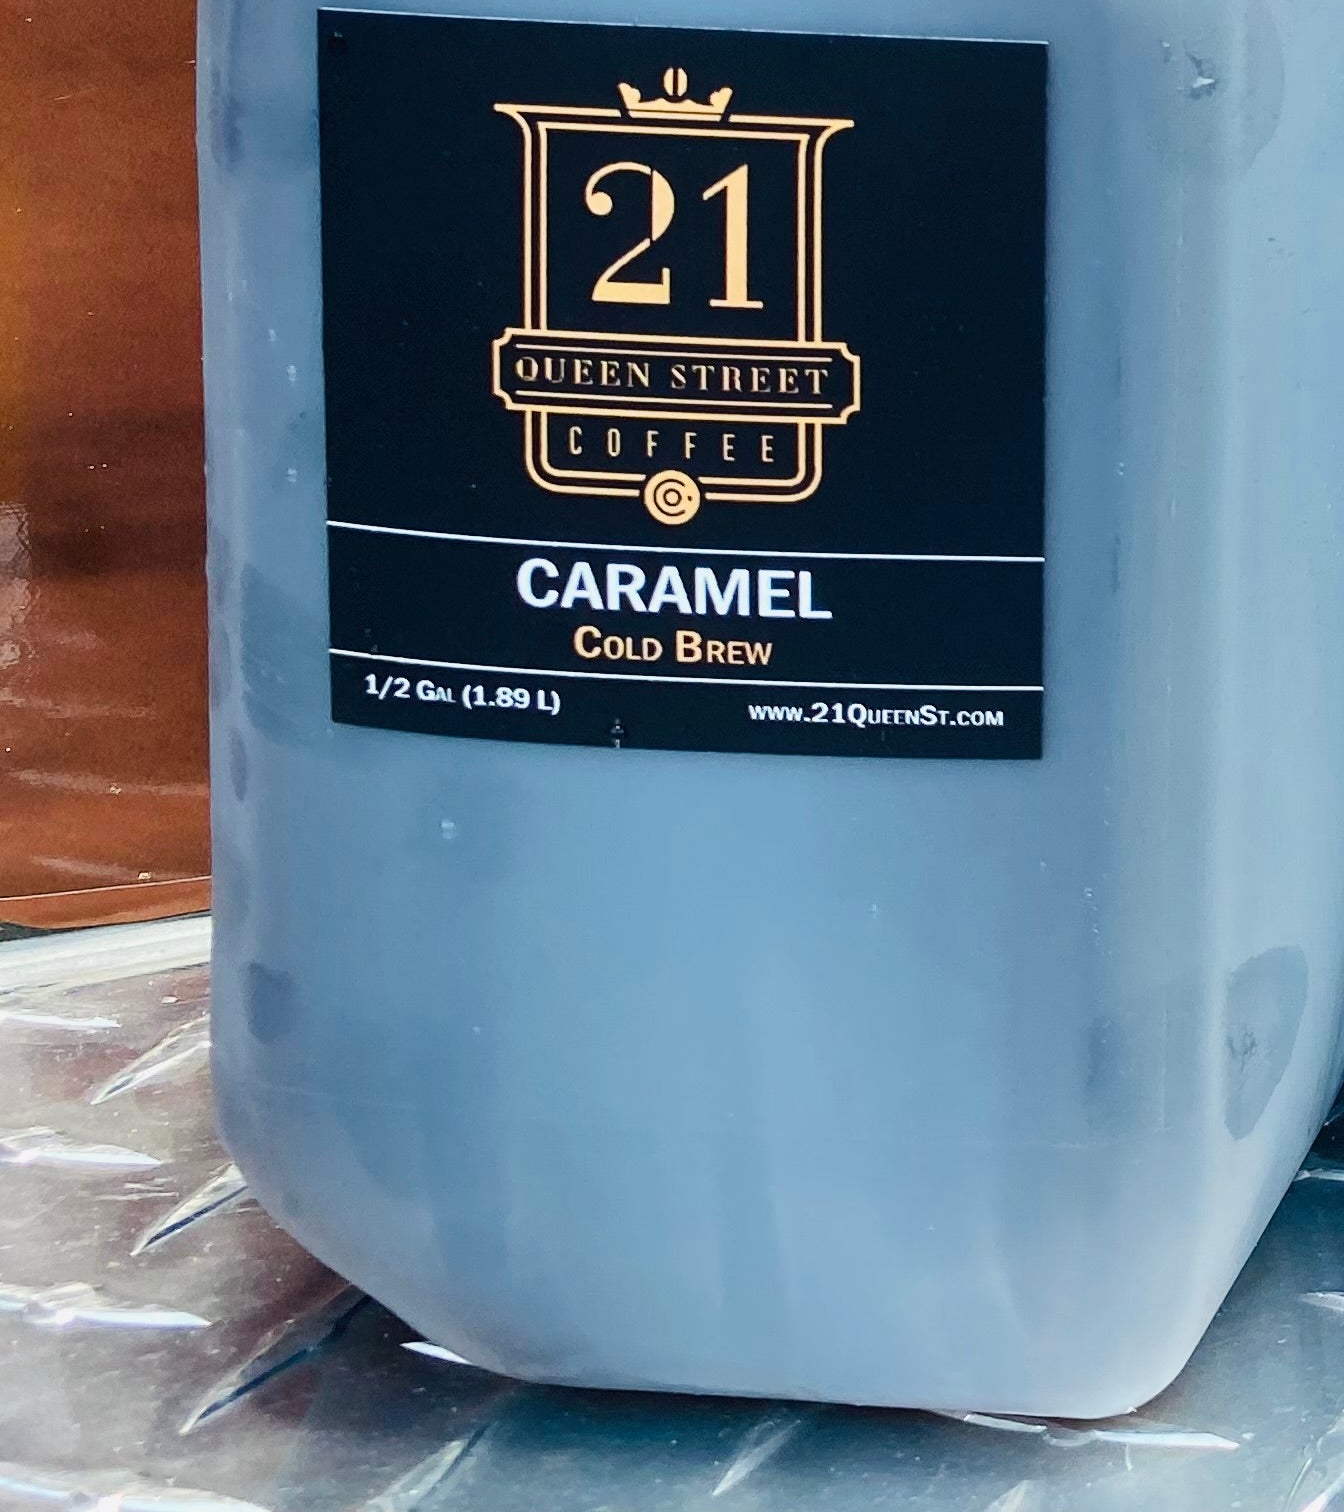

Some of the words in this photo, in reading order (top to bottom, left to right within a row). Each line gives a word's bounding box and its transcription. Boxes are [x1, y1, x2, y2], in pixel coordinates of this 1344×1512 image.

[584, 160, 764, 311] 21
[514, 355, 652, 388] QUEEN
[670, 363, 830, 395] STREET
[568, 425, 775, 463] COFFEE
[515, 556, 833, 620] CARAMEL
[364, 674, 412, 700] 1/2
[462, 683, 529, 710] (1.89
[536, 689, 562, 715] L)
